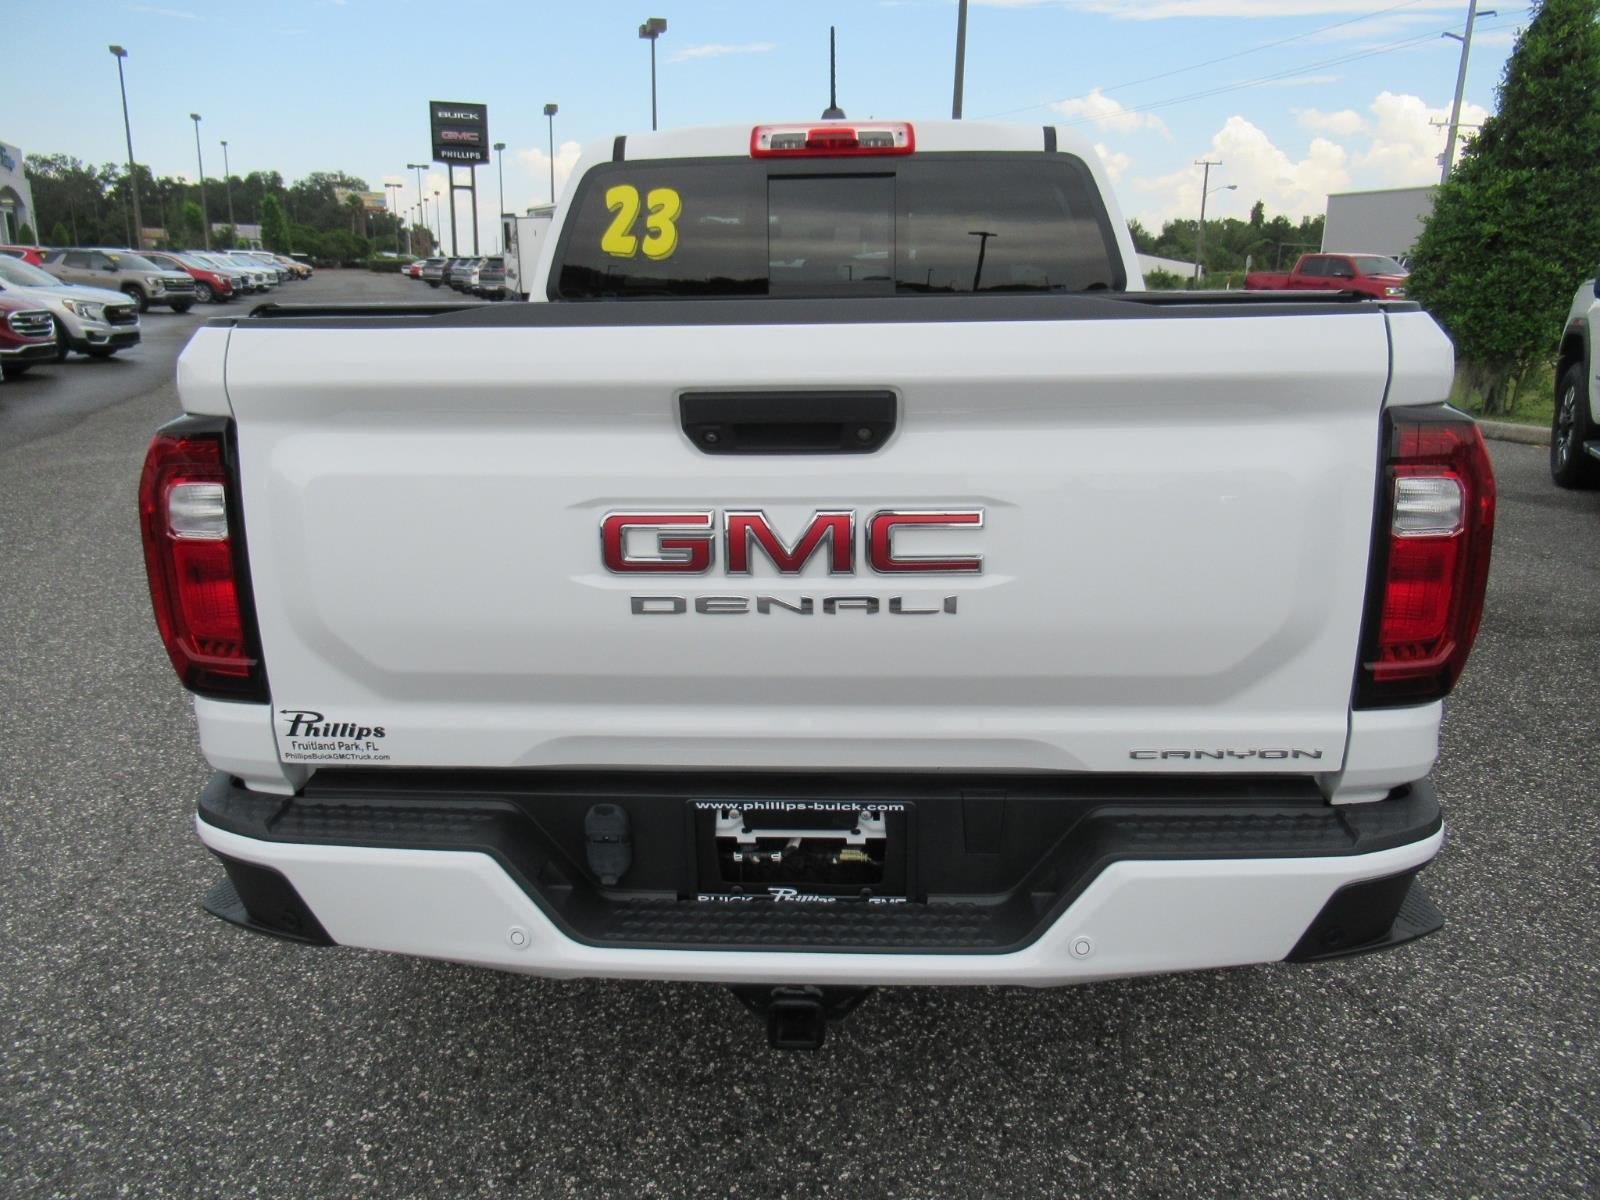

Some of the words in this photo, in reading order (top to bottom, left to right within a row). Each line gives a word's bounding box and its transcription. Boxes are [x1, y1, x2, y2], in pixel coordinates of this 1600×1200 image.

[437, 111, 480, 120] BUICK
[441, 131, 479, 142] GMC
[441, 150, 481, 160] PHILLIPS
[601, 184, 682, 261] 23
[599, 508, 985, 577] GMC
[630, 594, 959, 617] DENALI
[280, 709, 386, 740] Phillips
[292, 741, 336, 751] Fruitland
[338, 741, 364, 752] Park,
[366, 742, 379, 751] FL
[285, 752, 391, 761] PhillipsBuickGMCTruck.com
[1129, 749, 1323, 760] CANYON
[696, 801, 905, 812] www.phillips-buick.com
